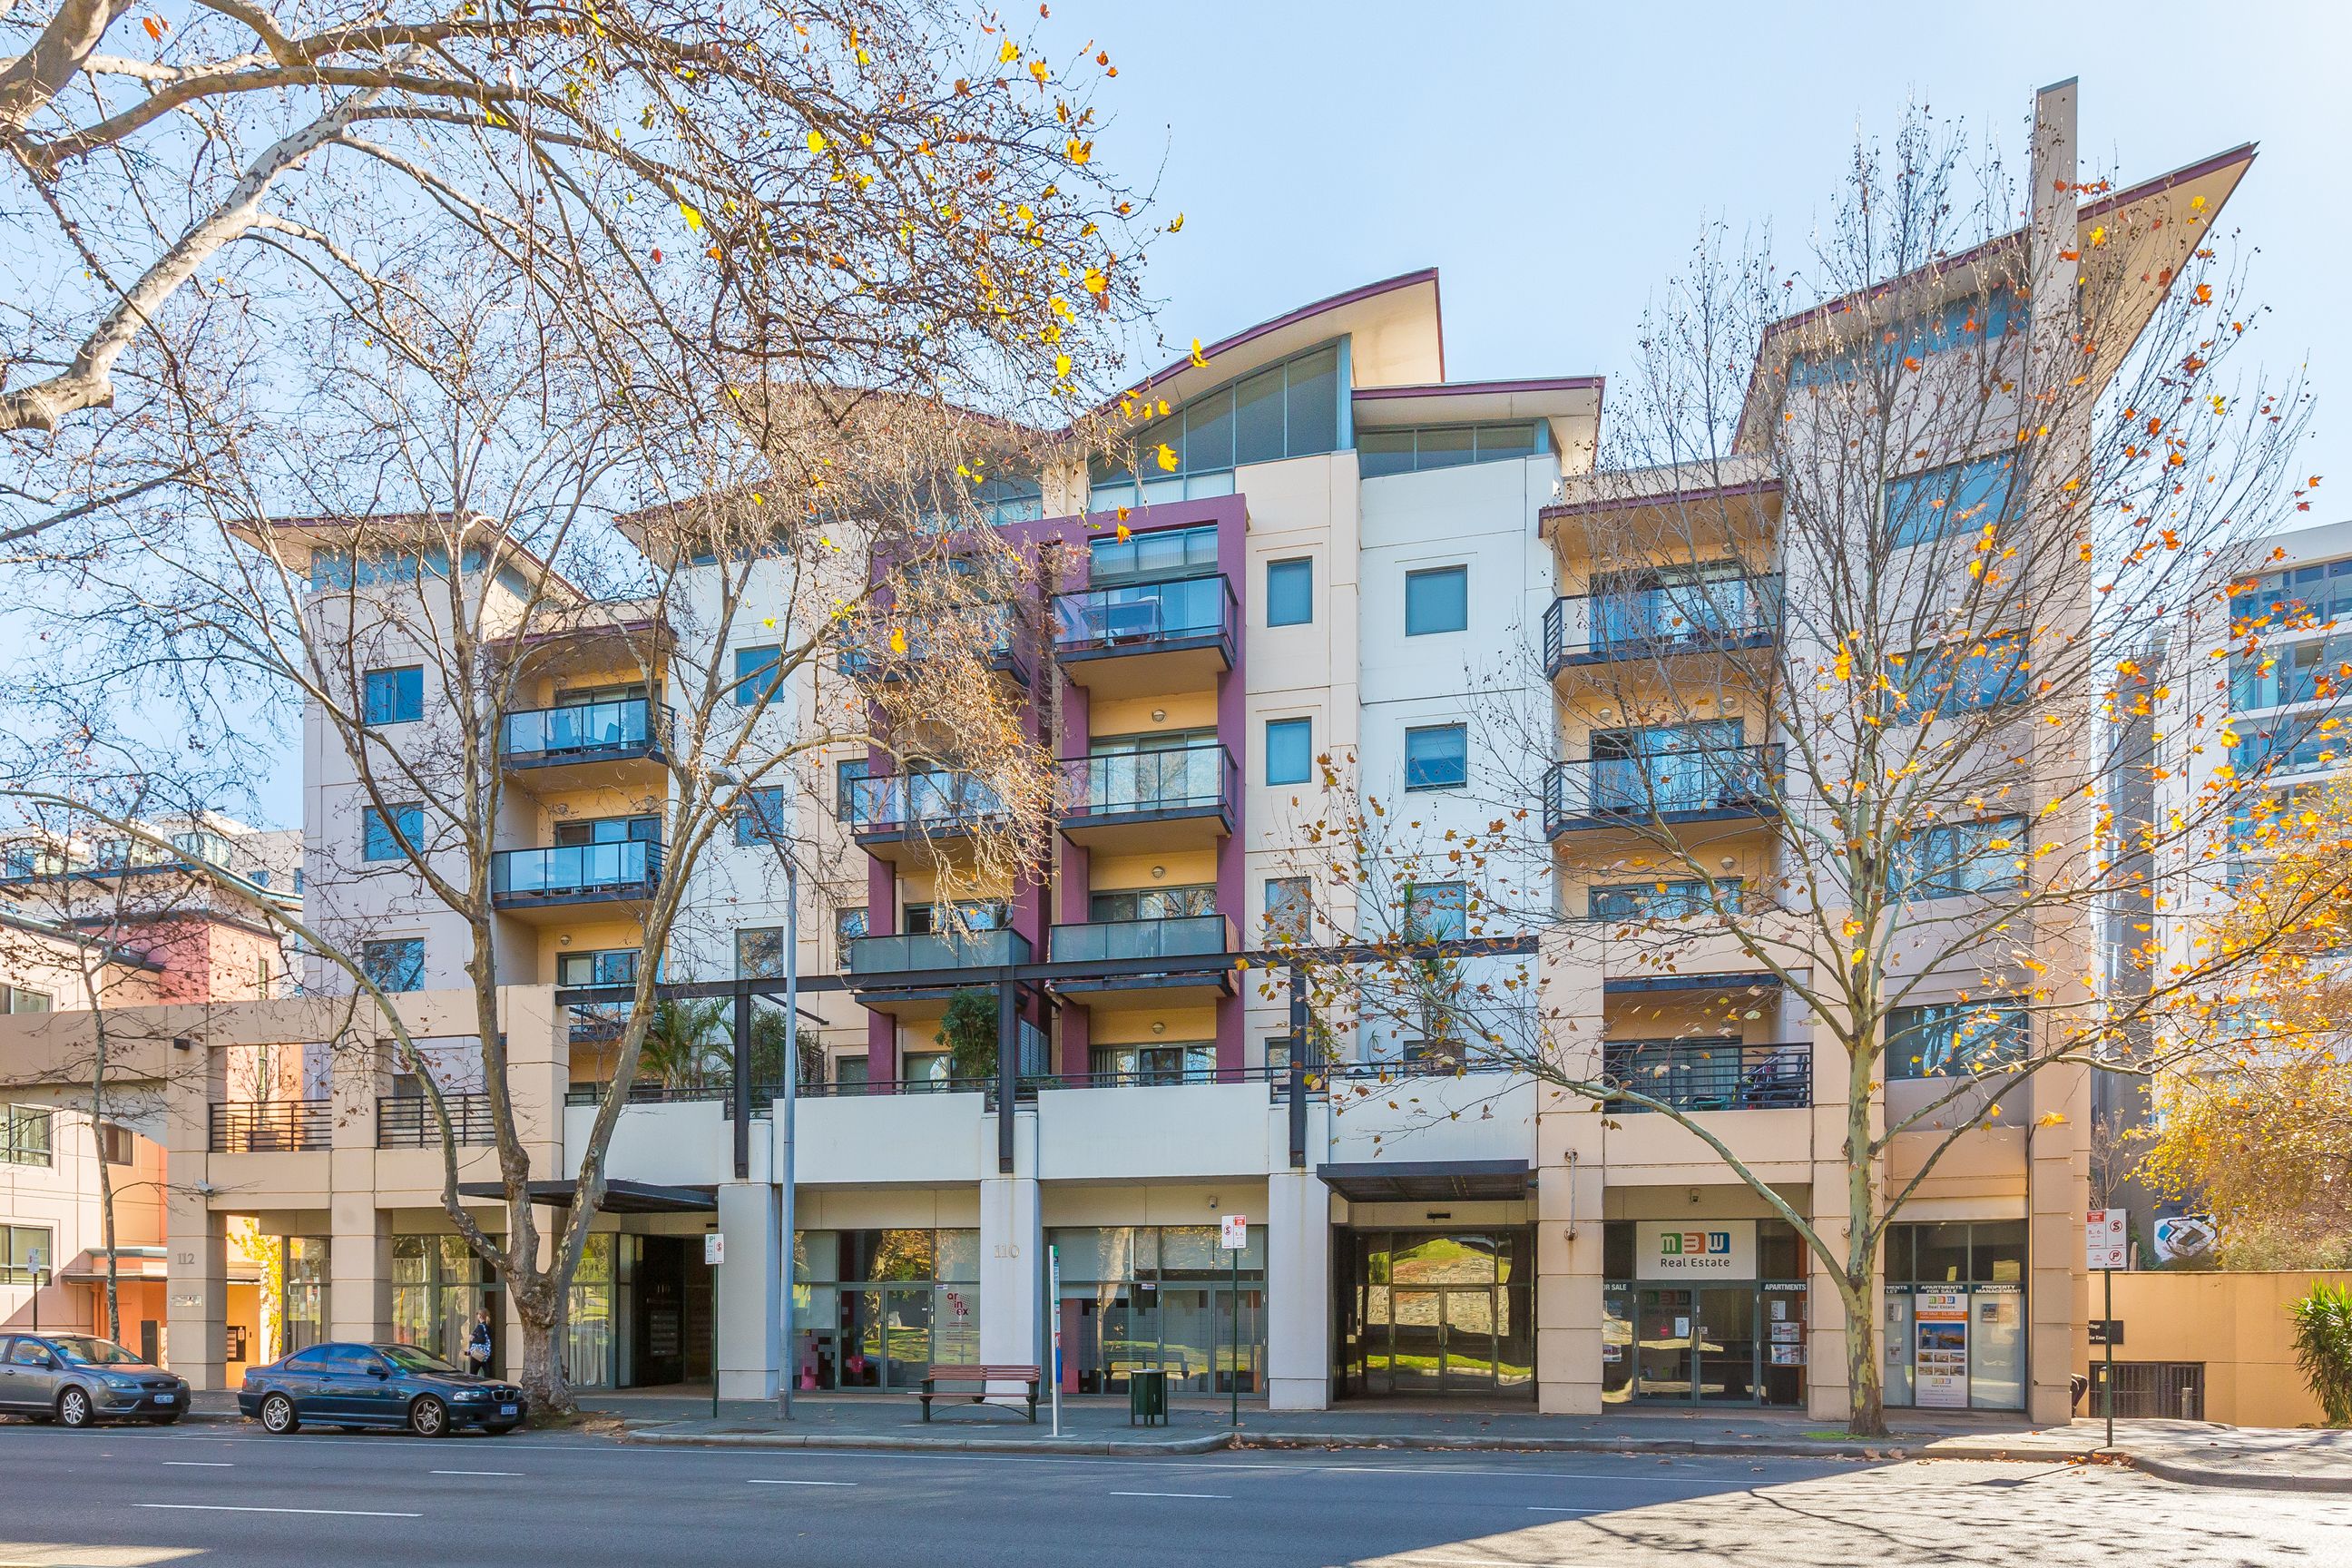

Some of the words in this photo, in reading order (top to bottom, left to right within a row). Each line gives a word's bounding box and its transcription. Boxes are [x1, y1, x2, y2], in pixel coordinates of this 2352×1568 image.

[995, 1244, 1020, 1259] 110
[177, 1253, 195, 1264] 112
[1661, 1258, 1687, 1267] Real
[1691, 1258, 1730, 1267] Estate
[955, 1300, 963, 1308] in
[956, 1308, 969, 1316] ex
